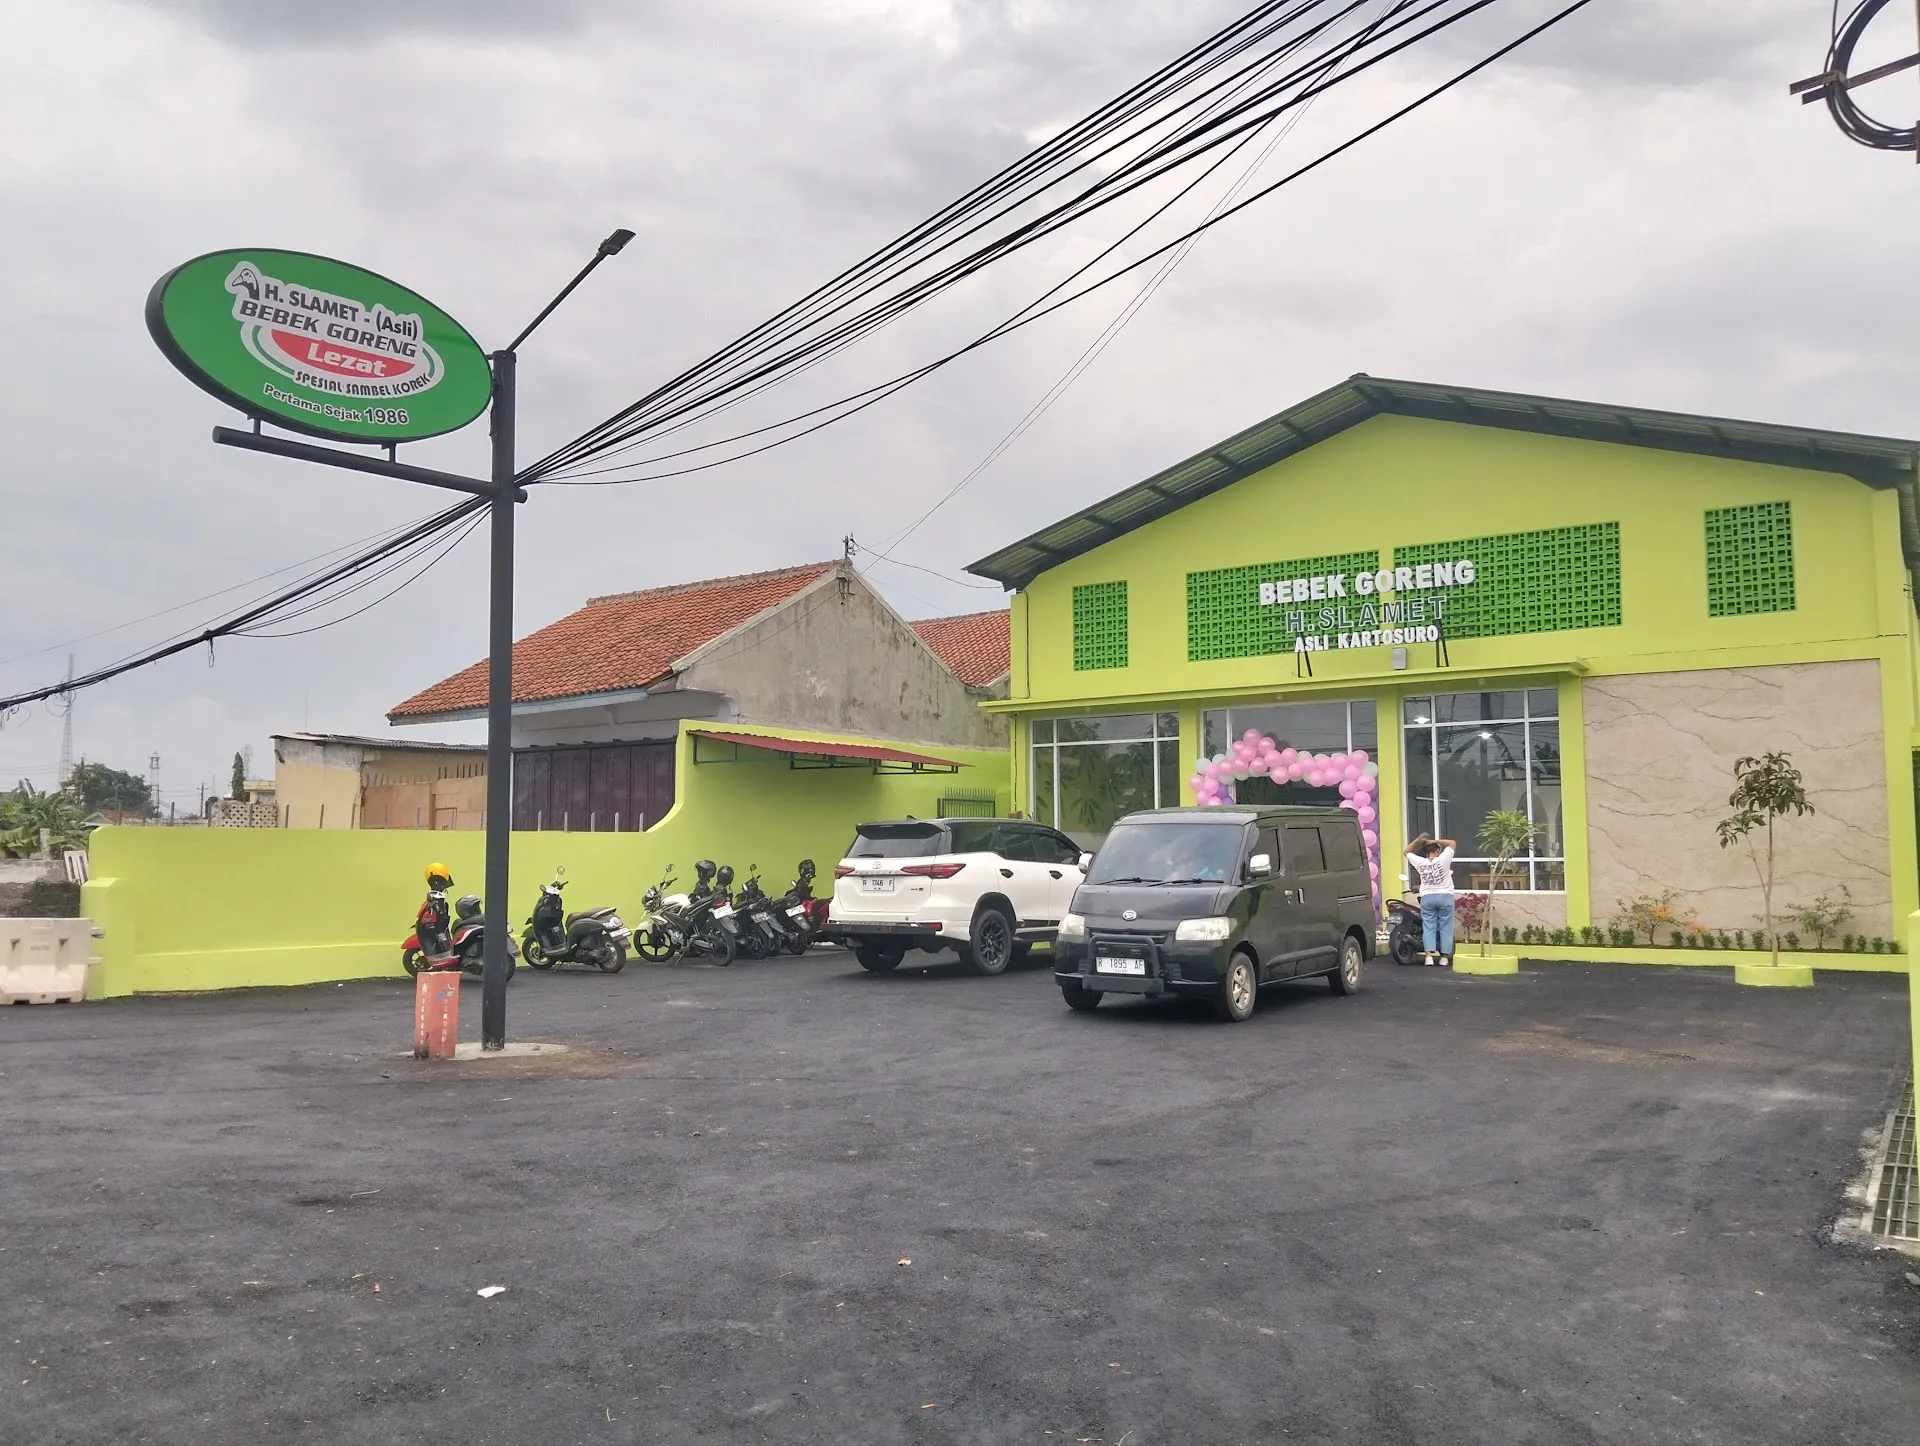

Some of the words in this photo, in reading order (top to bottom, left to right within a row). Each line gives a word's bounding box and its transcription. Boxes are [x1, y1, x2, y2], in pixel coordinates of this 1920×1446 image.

[240, 299, 319, 333] BEBEK
[327, 322, 417, 357] GORENG
[265, 283, 284, 303] H.
[289, 290, 359, 323] SLAMET
[376, 310, 417, 341] (Asli)
[307, 343, 387, 377] Lezat
[295, 370, 343, 393] SPESIAL
[345, 383, 391, 397] SAMBEL
[392, 373, 431, 395] KOREK
[264, 384, 321, 413] Pertama
[325, 405, 361, 421] Sejak
[364, 408, 409, 424] 1986
[1259, 574, 1347, 606] BEBEK
[1355, 559, 1475, 596] GORENG
[1294, 634, 1329, 653] ASLI
[1338, 624, 1439, 649] KARTOSURO
[1098, 957, 1103, 968] R
[1110, 958, 1128, 969] 1895
